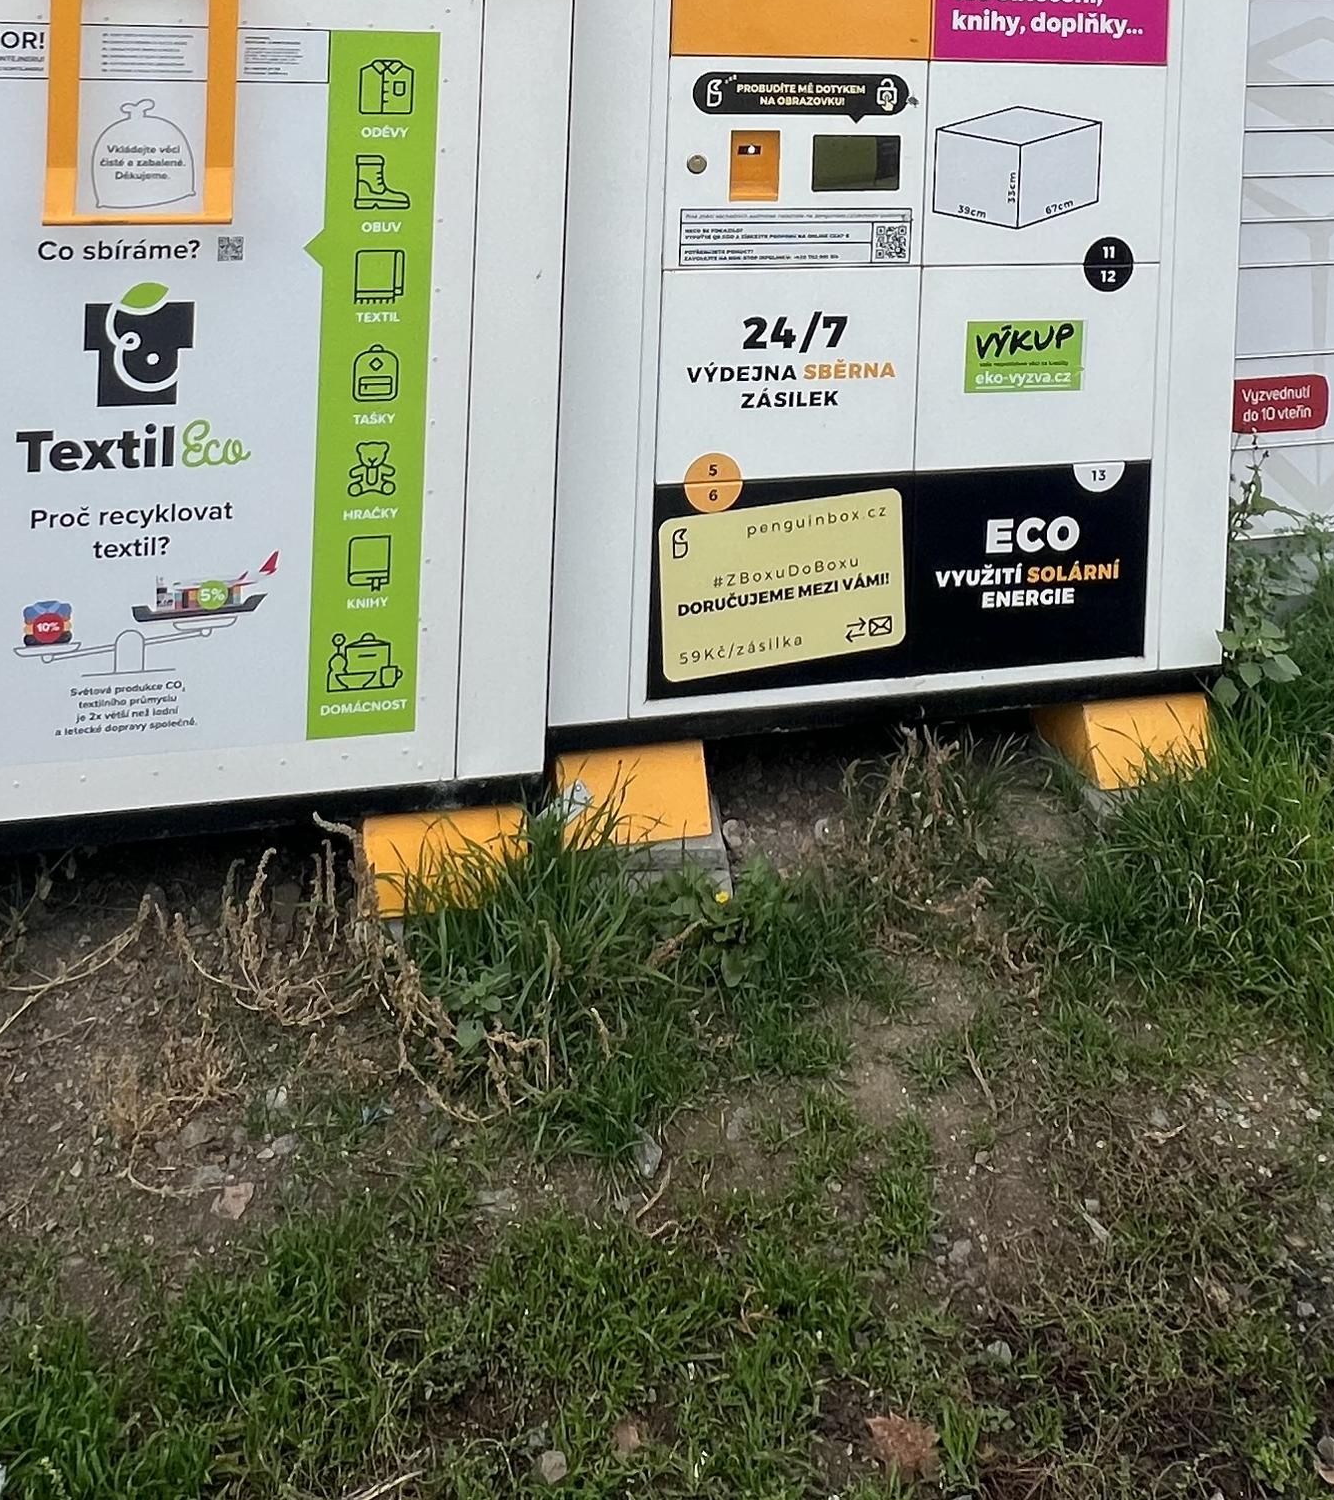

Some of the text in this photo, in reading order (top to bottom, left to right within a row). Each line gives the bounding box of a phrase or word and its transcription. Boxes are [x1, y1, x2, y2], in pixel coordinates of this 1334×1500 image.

[952, 10, 1144, 39] knihy, doplňky...
[736, 82, 866, 95] PROBUDÍTE MĚ DOTYKEM
[760, 96, 845, 106] NA OBRAZOVKU!
[361, 126, 409, 138] ODĚVY
[957, 204, 987, 219] 39cm
[1045, 200, 1074, 215] 67cm
[361, 222, 402, 233] OBUV
[37, 239, 201, 260] Co sbíráme?
[1102, 246, 1116, 260] 11
[1101, 269, 1117, 283] 12
[356, 312, 401, 323] TEXTIL
[743, 311, 848, 353] 24/7
[976, 323, 1074, 359] VÝKUP
[687, 359, 896, 383] VÝDEJNA SBĚRNA
[975, 371, 1072, 387] eko-vyzva.cz
[741, 388, 839, 409] ZÁSILEK
[1241, 385, 1311, 405] Vyzvednutí
[353, 412, 396, 425] TAŠKY
[1243, 405, 1312, 422] do 10 vteřin
[708, 464, 718, 477] 5
[1091, 470, 1106, 481] 13
[708, 489, 718, 501] 6
[30, 501, 233, 529] Proč recyklovat
[343, 507, 399, 521] HRAČKY
[747, 506, 887, 538] penguinbox.cz
[985, 515, 1080, 554] ECO
[93, 536, 171, 559] textil?
[713, 557, 859, 588] #ZBoxuDoBoxu
[935, 559, 1120, 588] VYUŽITÍ SOLÁRNÍ
[200, 588, 226, 602] 5%
[678, 572, 890, 617] DORUČUJEME MEZI VÁMI!
[982, 588, 1075, 609] ENERGIE
[347, 596, 388, 609] KNIHY
[36, 621, 60, 633] 10%
[679, 634, 803, 665] 59Kč/zásilka
[114, 682, 163, 696] produkce
[320, 699, 408, 716] DOMÁCNOST
[89, 711, 102, 721] 2x
